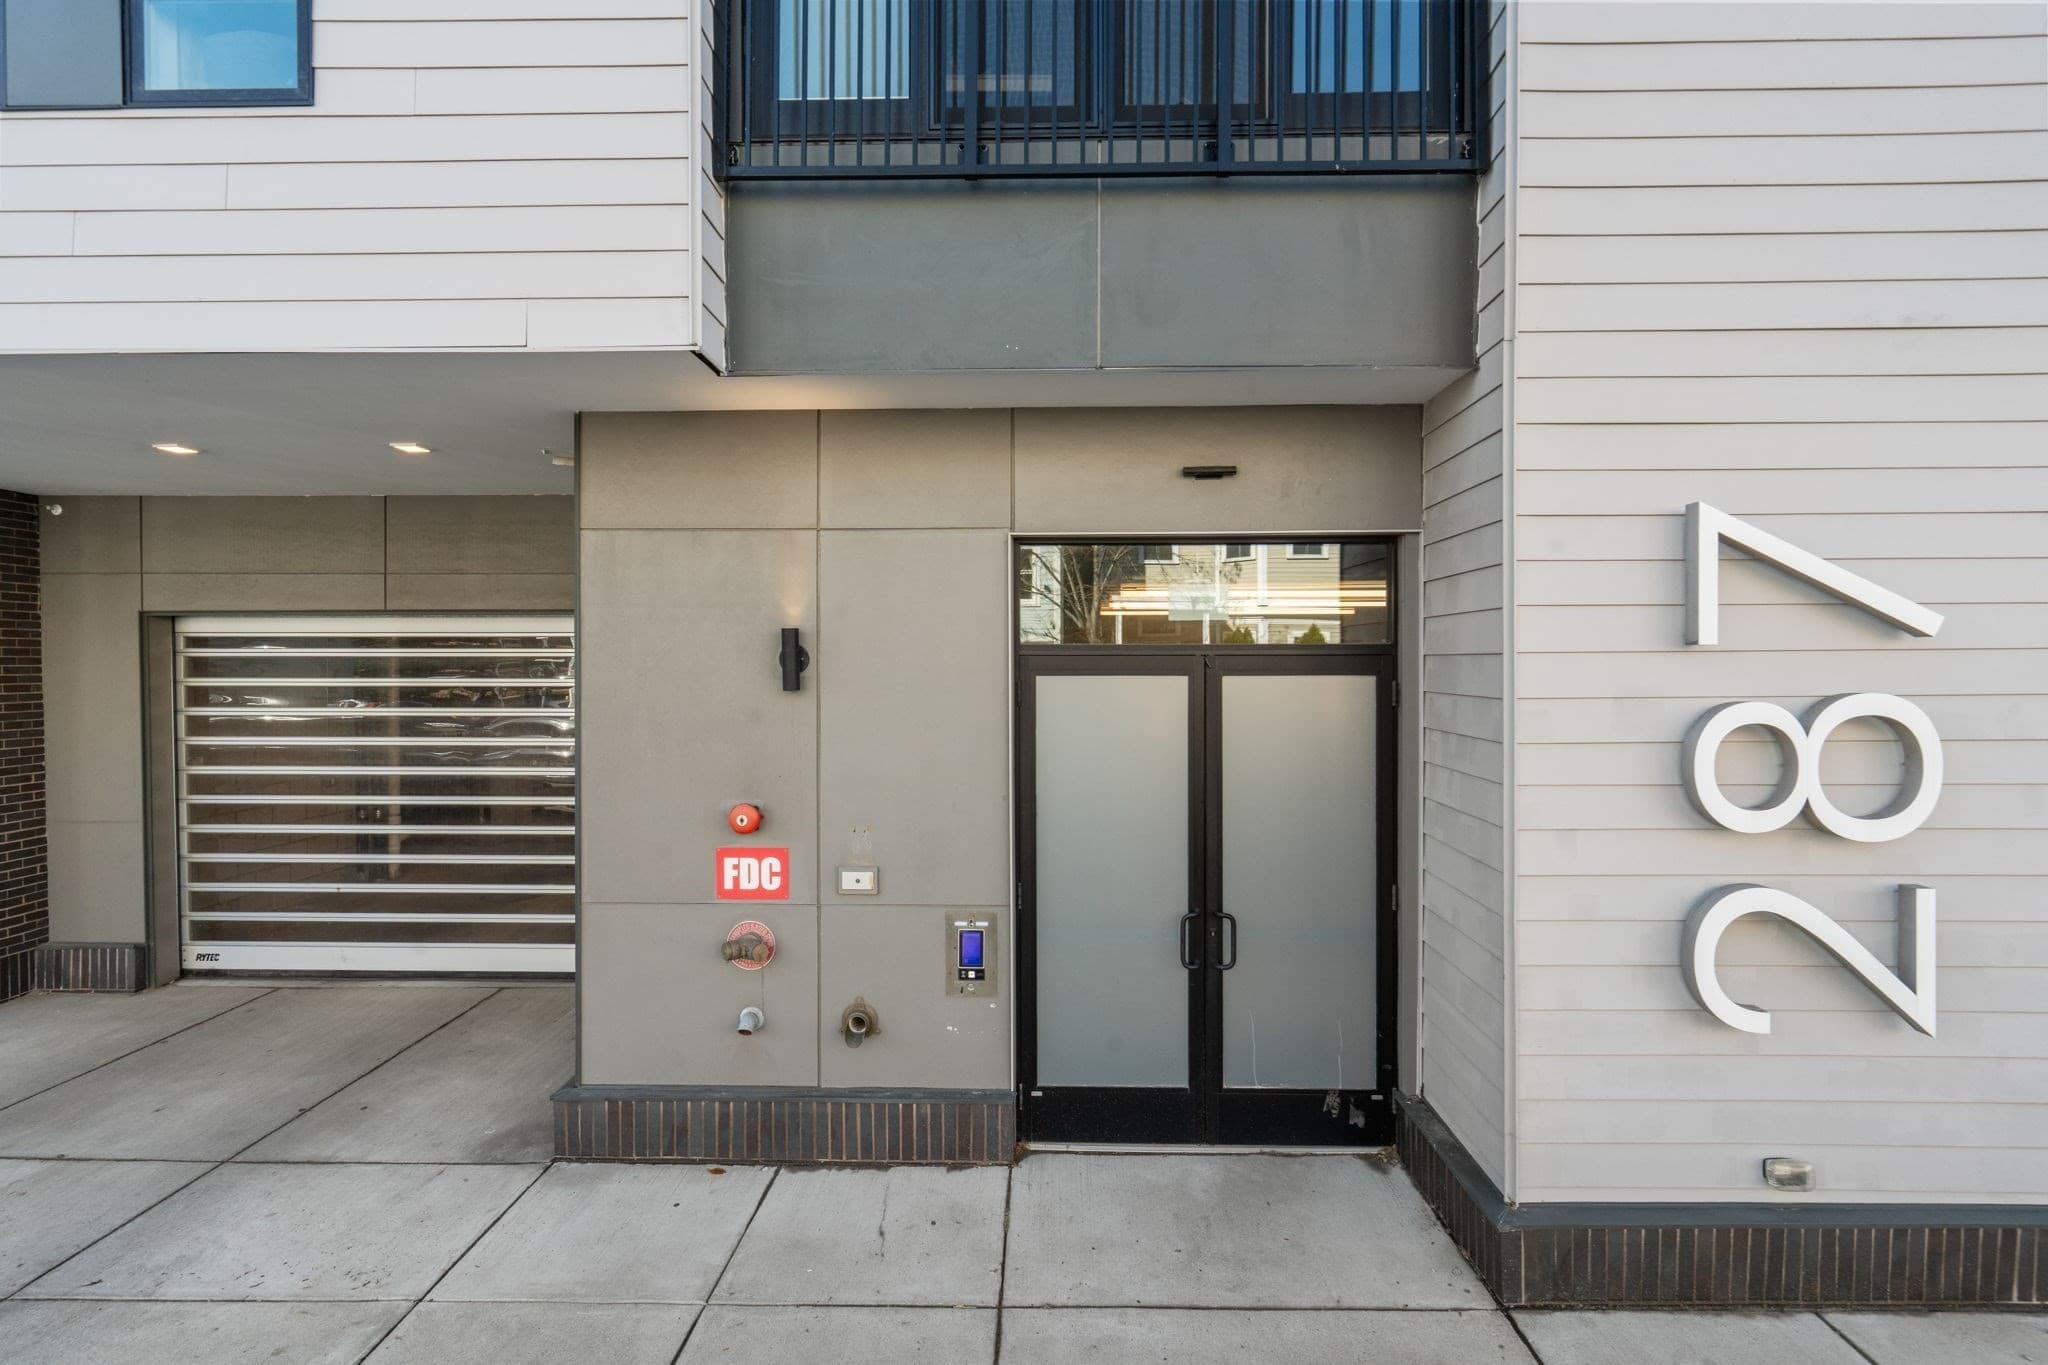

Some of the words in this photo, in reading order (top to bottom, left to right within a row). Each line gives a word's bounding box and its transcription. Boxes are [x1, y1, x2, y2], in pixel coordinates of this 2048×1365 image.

[1683, 501, 1944, 1038] 287
[723, 857, 781, 890] FDC
[195, 953, 220, 961] RYTEC
